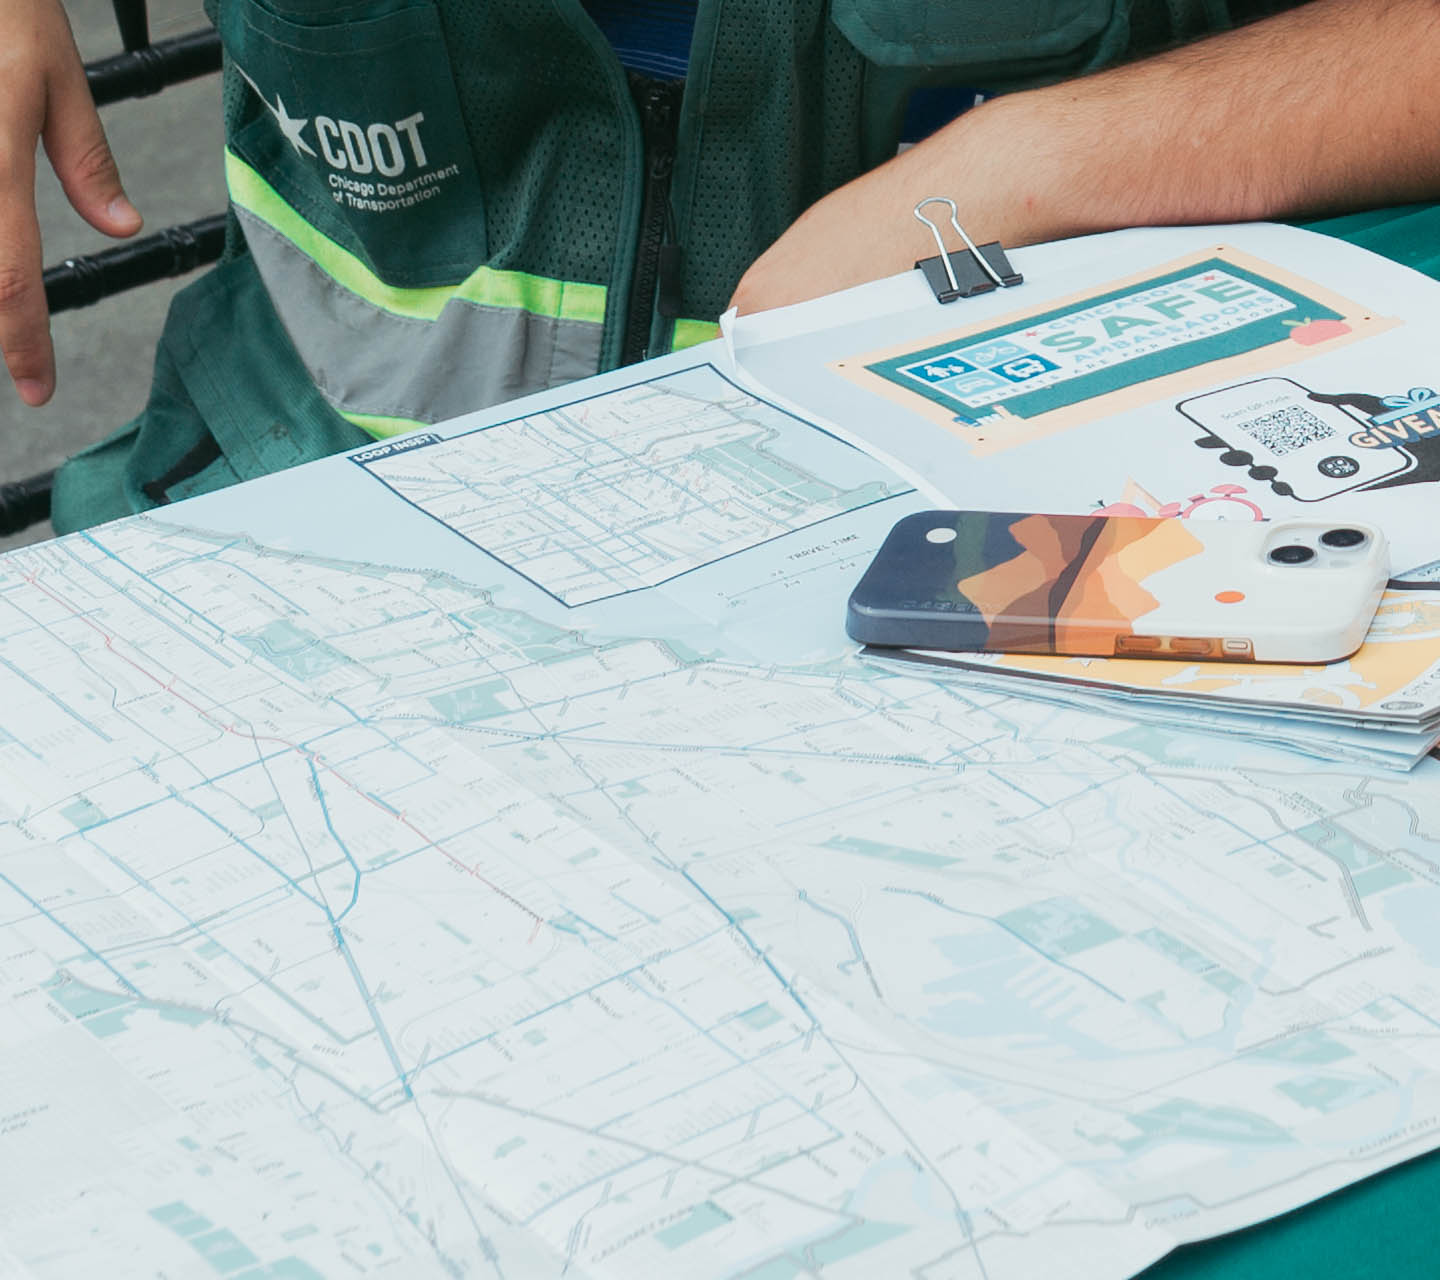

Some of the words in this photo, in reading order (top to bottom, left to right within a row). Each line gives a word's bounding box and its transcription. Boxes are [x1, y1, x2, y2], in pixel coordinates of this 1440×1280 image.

[315, 111, 428, 178] CDOT
[328, 173, 375, 198] Chicago
[376, 163, 460, 197] Department
[332, 190, 344, 204] of
[345, 185, 441, 213] Transportation
[1040, 279, 1257, 353] SAFE
[1074, 296, 1276, 366] AMBASSADORS
[353, 445, 394, 464] LOOP
[394, 434, 433, 454] INSET
